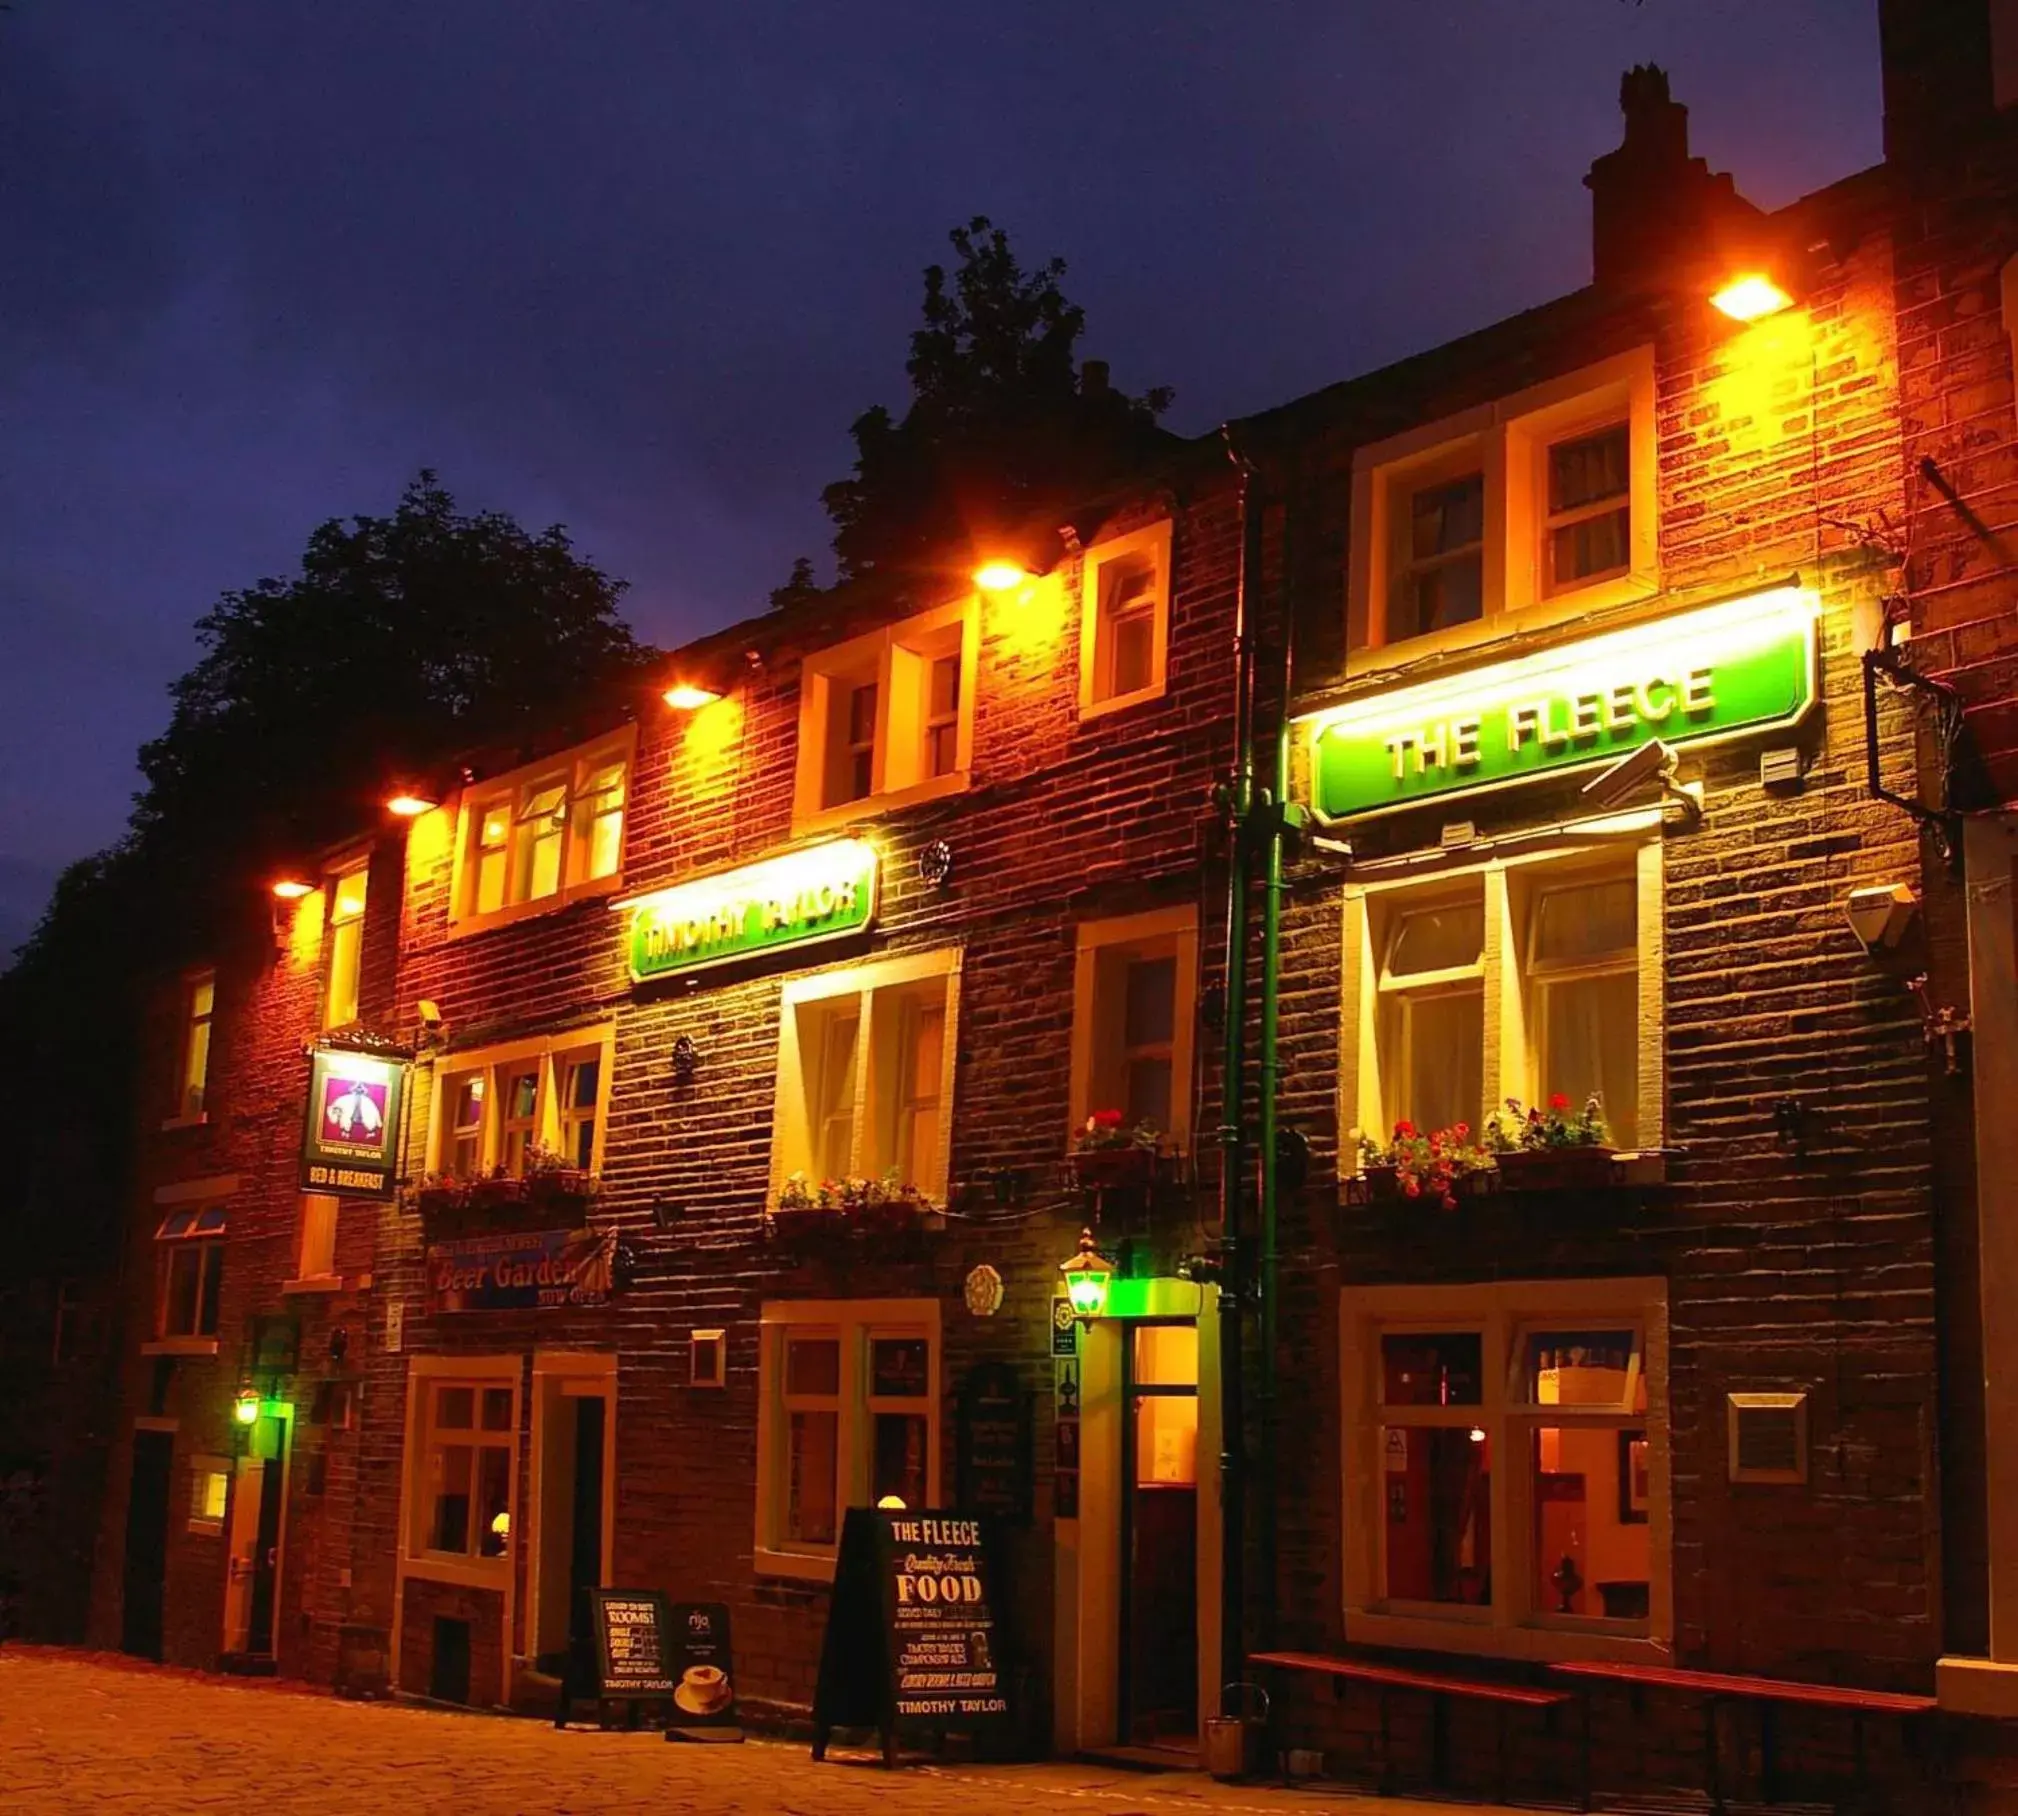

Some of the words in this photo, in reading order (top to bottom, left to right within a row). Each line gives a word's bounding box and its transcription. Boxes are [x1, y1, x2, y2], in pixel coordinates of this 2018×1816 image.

[1385, 715, 1483, 780] THE
[1507, 666, 1716, 752] FLEECE
[310, 1166, 328, 1183] BED
[436, 1262, 488, 1292] Beer
[891, 1521, 921, 1542] THE
[922, 1519, 982, 1546] FLEECE
[896, 1574, 982, 1603] FOOD
[604, 1679, 642, 1688] TIMOTHY
[642, 1680, 674, 1689] TAYLOR
[896, 1700, 956, 1714] TIMOTHY
[958, 1699, 1007, 1713] TAYLOR
